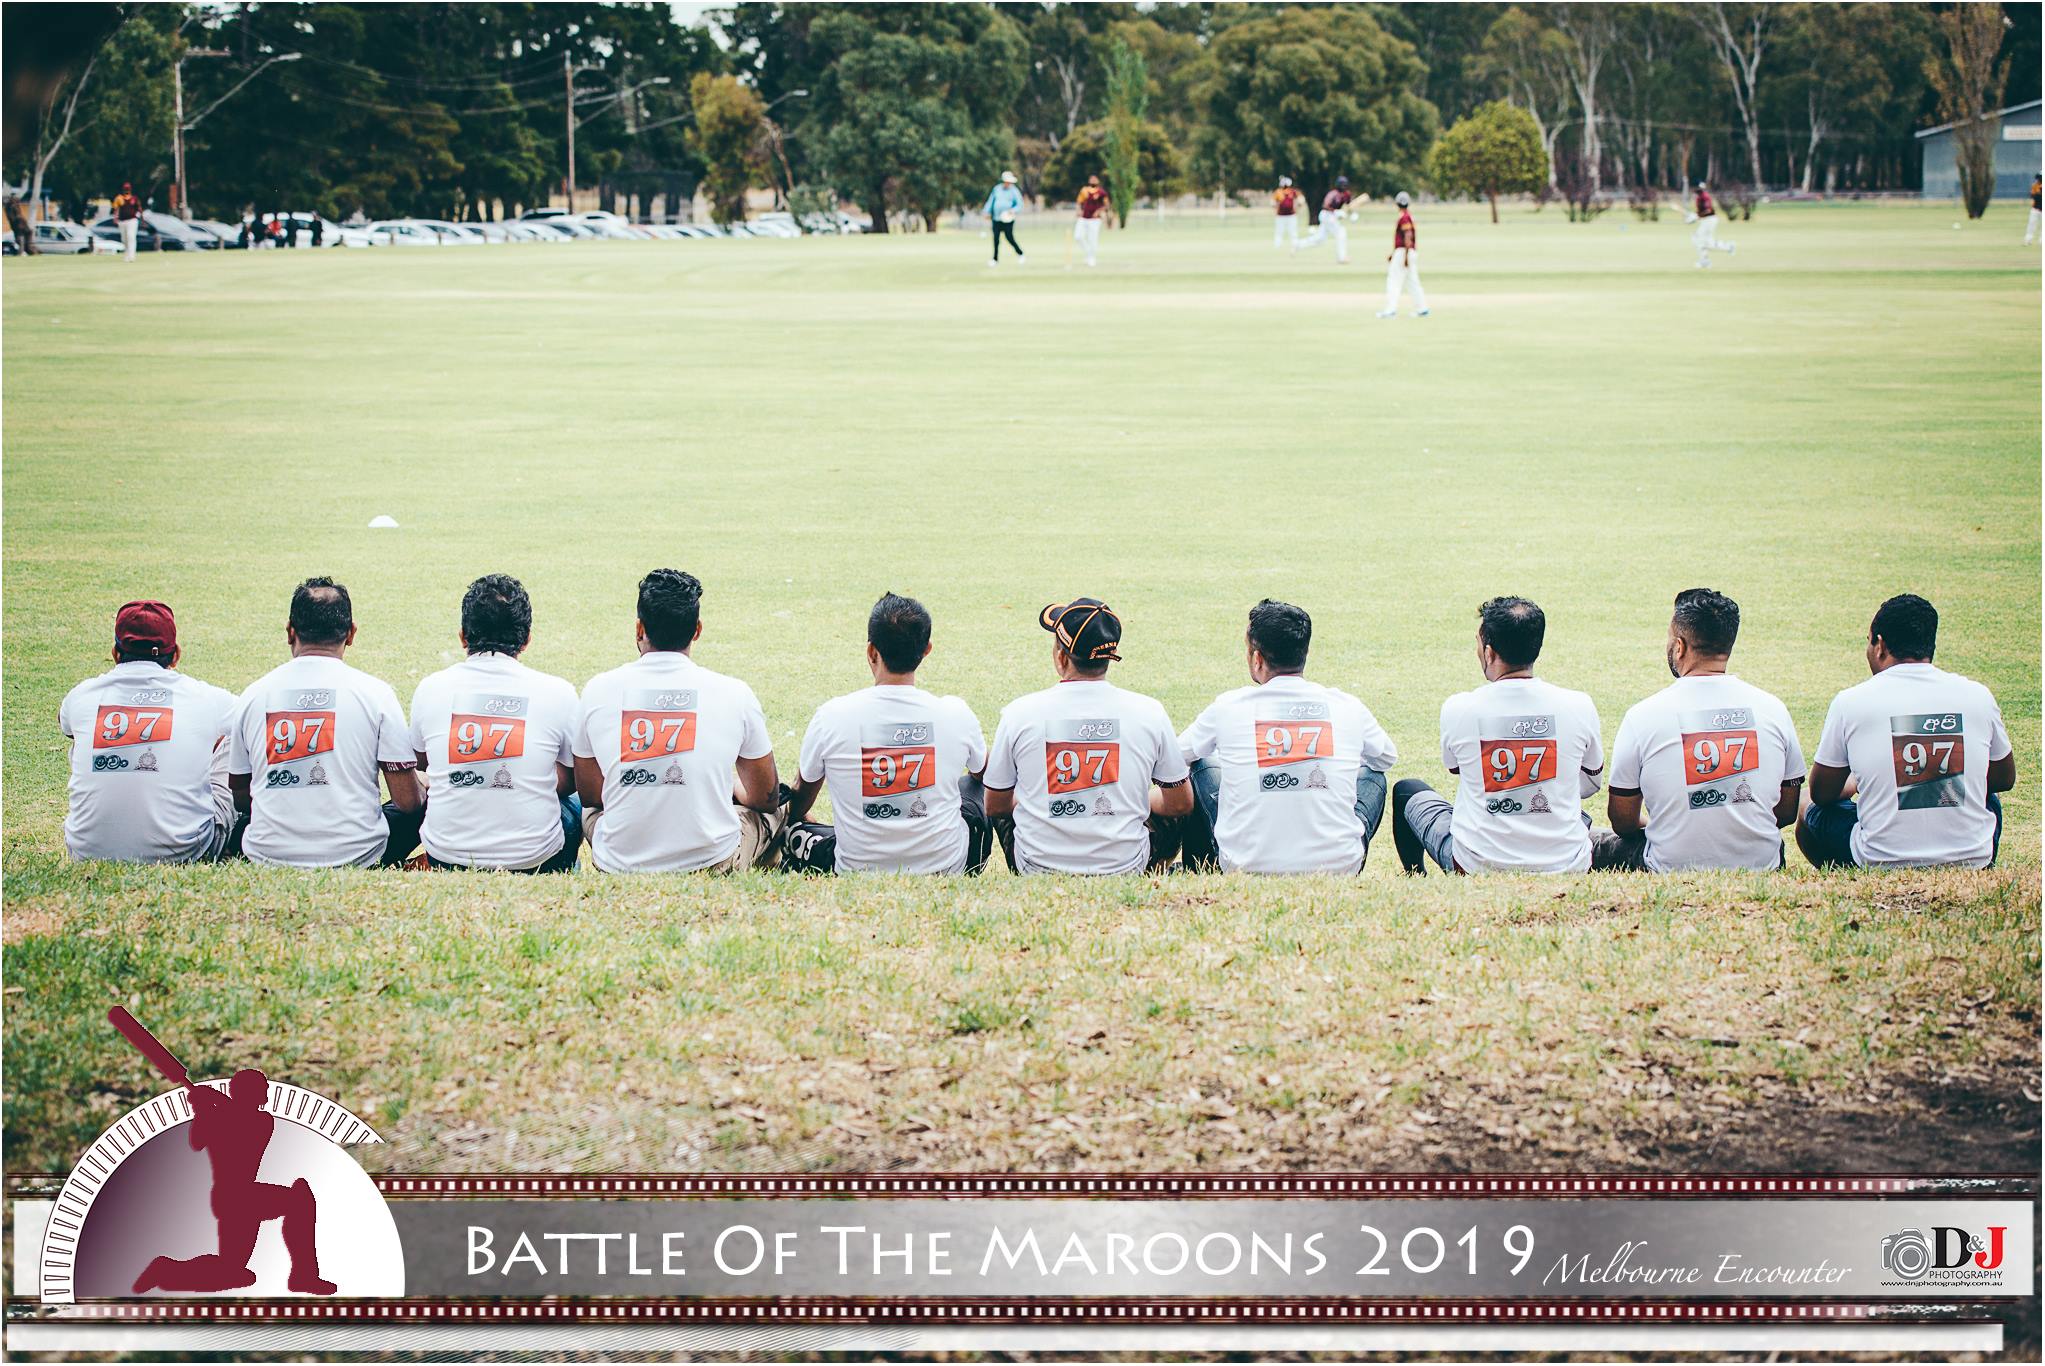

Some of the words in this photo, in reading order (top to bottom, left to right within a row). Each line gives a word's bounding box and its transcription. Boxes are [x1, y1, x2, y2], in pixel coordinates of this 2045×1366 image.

[102, 711, 163, 741] 97
[273, 718, 325, 754] 97
[457, 721, 514, 757] 97
[629, 718, 687, 752] 97
[1265, 726, 1323, 757] 97
[871, 753, 926, 789] 97
[1055, 749, 1110, 784] 97
[1490, 746, 1547, 782] 97
[1693, 737, 1748, 774] 97
[1902, 741, 1955, 776] 97
